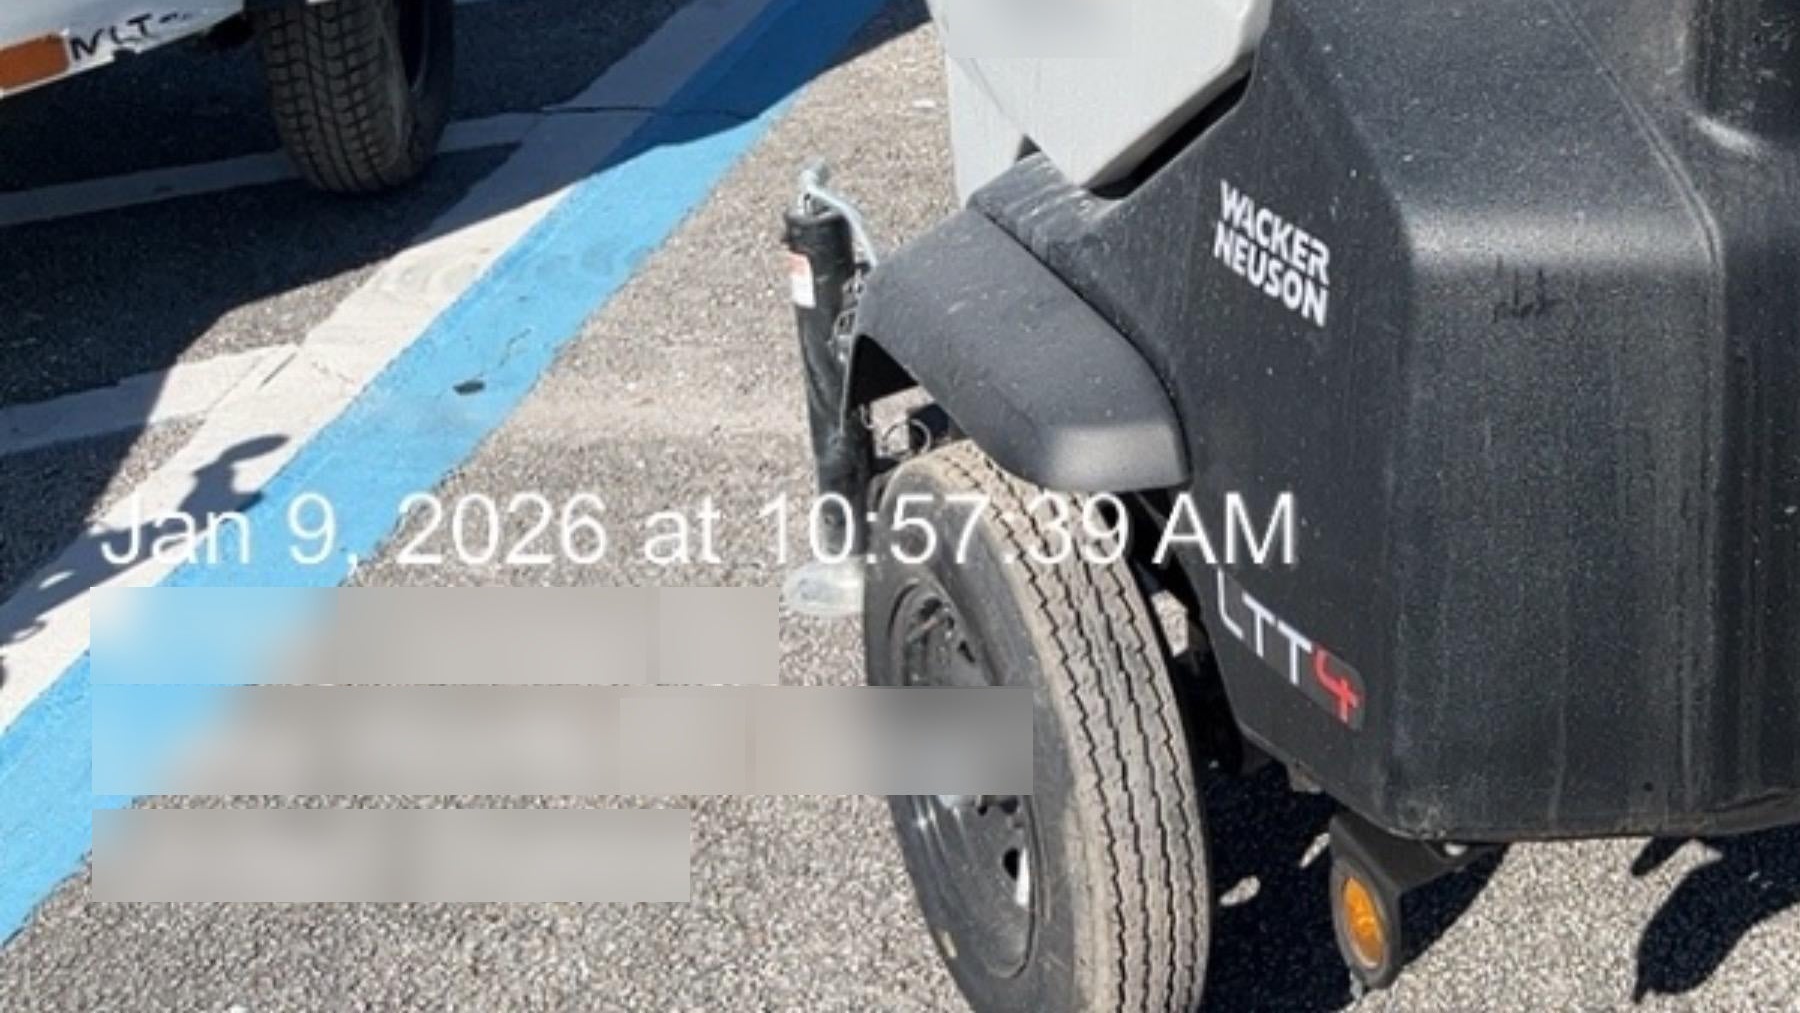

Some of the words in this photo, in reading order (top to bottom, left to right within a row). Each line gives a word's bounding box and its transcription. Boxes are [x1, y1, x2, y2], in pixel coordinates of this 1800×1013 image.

[1214, 220, 1329, 328] NEUSON
[1219, 179, 1330, 286] WACKER
[1217, 567, 1359, 724] LTT4
